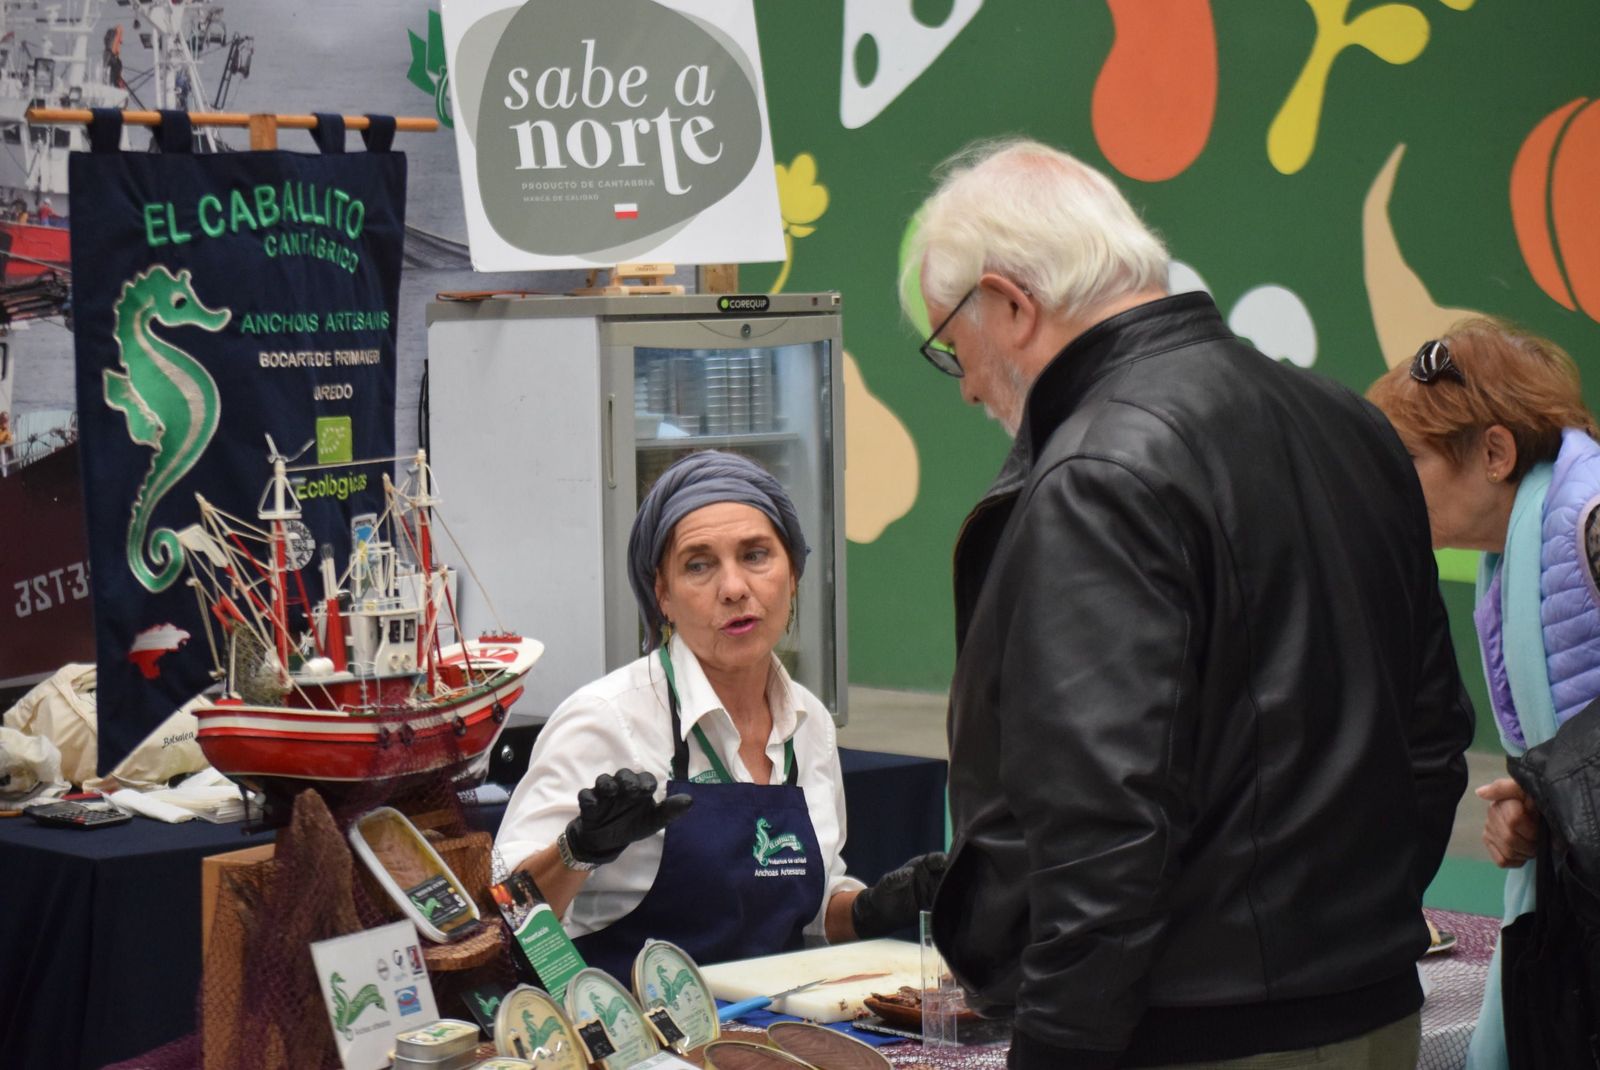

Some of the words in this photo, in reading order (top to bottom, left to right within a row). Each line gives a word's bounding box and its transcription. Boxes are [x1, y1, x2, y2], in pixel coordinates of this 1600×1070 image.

[504, 38, 648, 110] sabe
[674, 64, 716, 107] a
[508, 106, 723, 196] norte
[143, 201, 192, 247] EL
[198, 180, 365, 240] CABALLITO
[521, 181, 577, 191] PRODUCTO
[580, 180, 595, 189] DE
[597, 179, 656, 189] CANTABRIA
[754, 868, 779, 877] Anchoas
